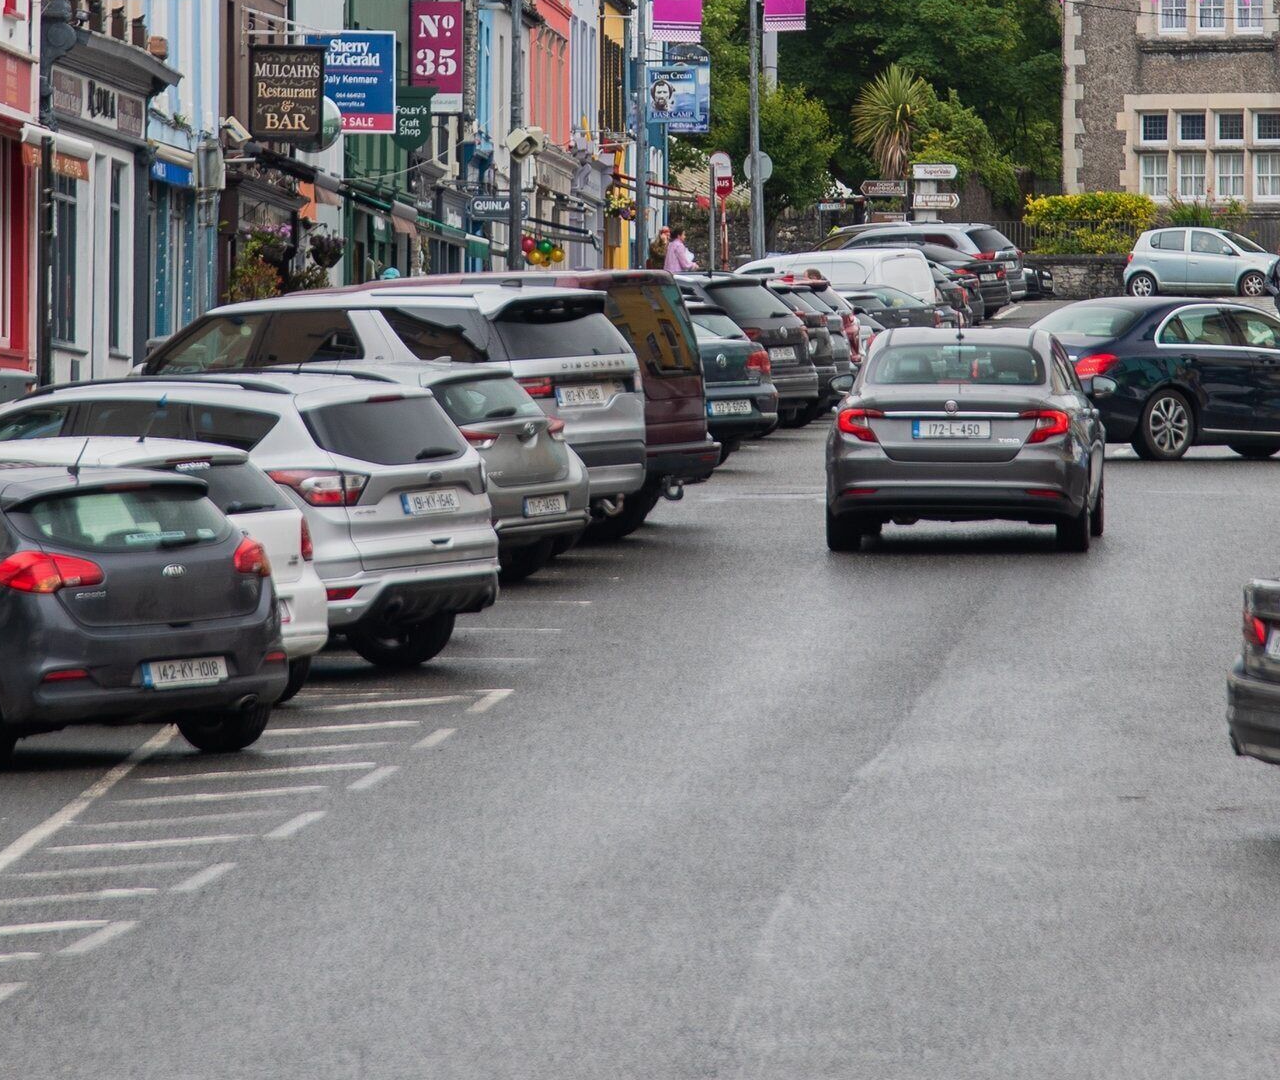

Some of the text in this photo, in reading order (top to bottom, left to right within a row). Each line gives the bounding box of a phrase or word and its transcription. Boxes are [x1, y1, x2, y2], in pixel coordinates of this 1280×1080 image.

[330, 39, 370, 56] Sherry
[415, 48, 458, 77] 35
[254, 62, 321, 79] MULCAHY'S
[651, 71, 692, 80] Tom Crean
[342, 73, 378, 84] Kenmare
[257, 83, 318, 98] Restaurant
[280, 100, 295, 112] &
[396, 105, 428, 115] FOLEY'S
[653, 111, 670, 120] BASE
[671, 111, 694, 120] CAMP
[265, 113, 311, 131] BAR
[349, 117, 375, 127] SALE
[399, 119, 420, 128] Craft
[399, 127, 422, 137] Shop
[473, 200, 526, 212] QUINLAS
[561, 360, 625, 370] DISCOVERY
[928, 422, 981, 437] 172-L-450
[157, 660, 220, 683] 142-KY-1018
